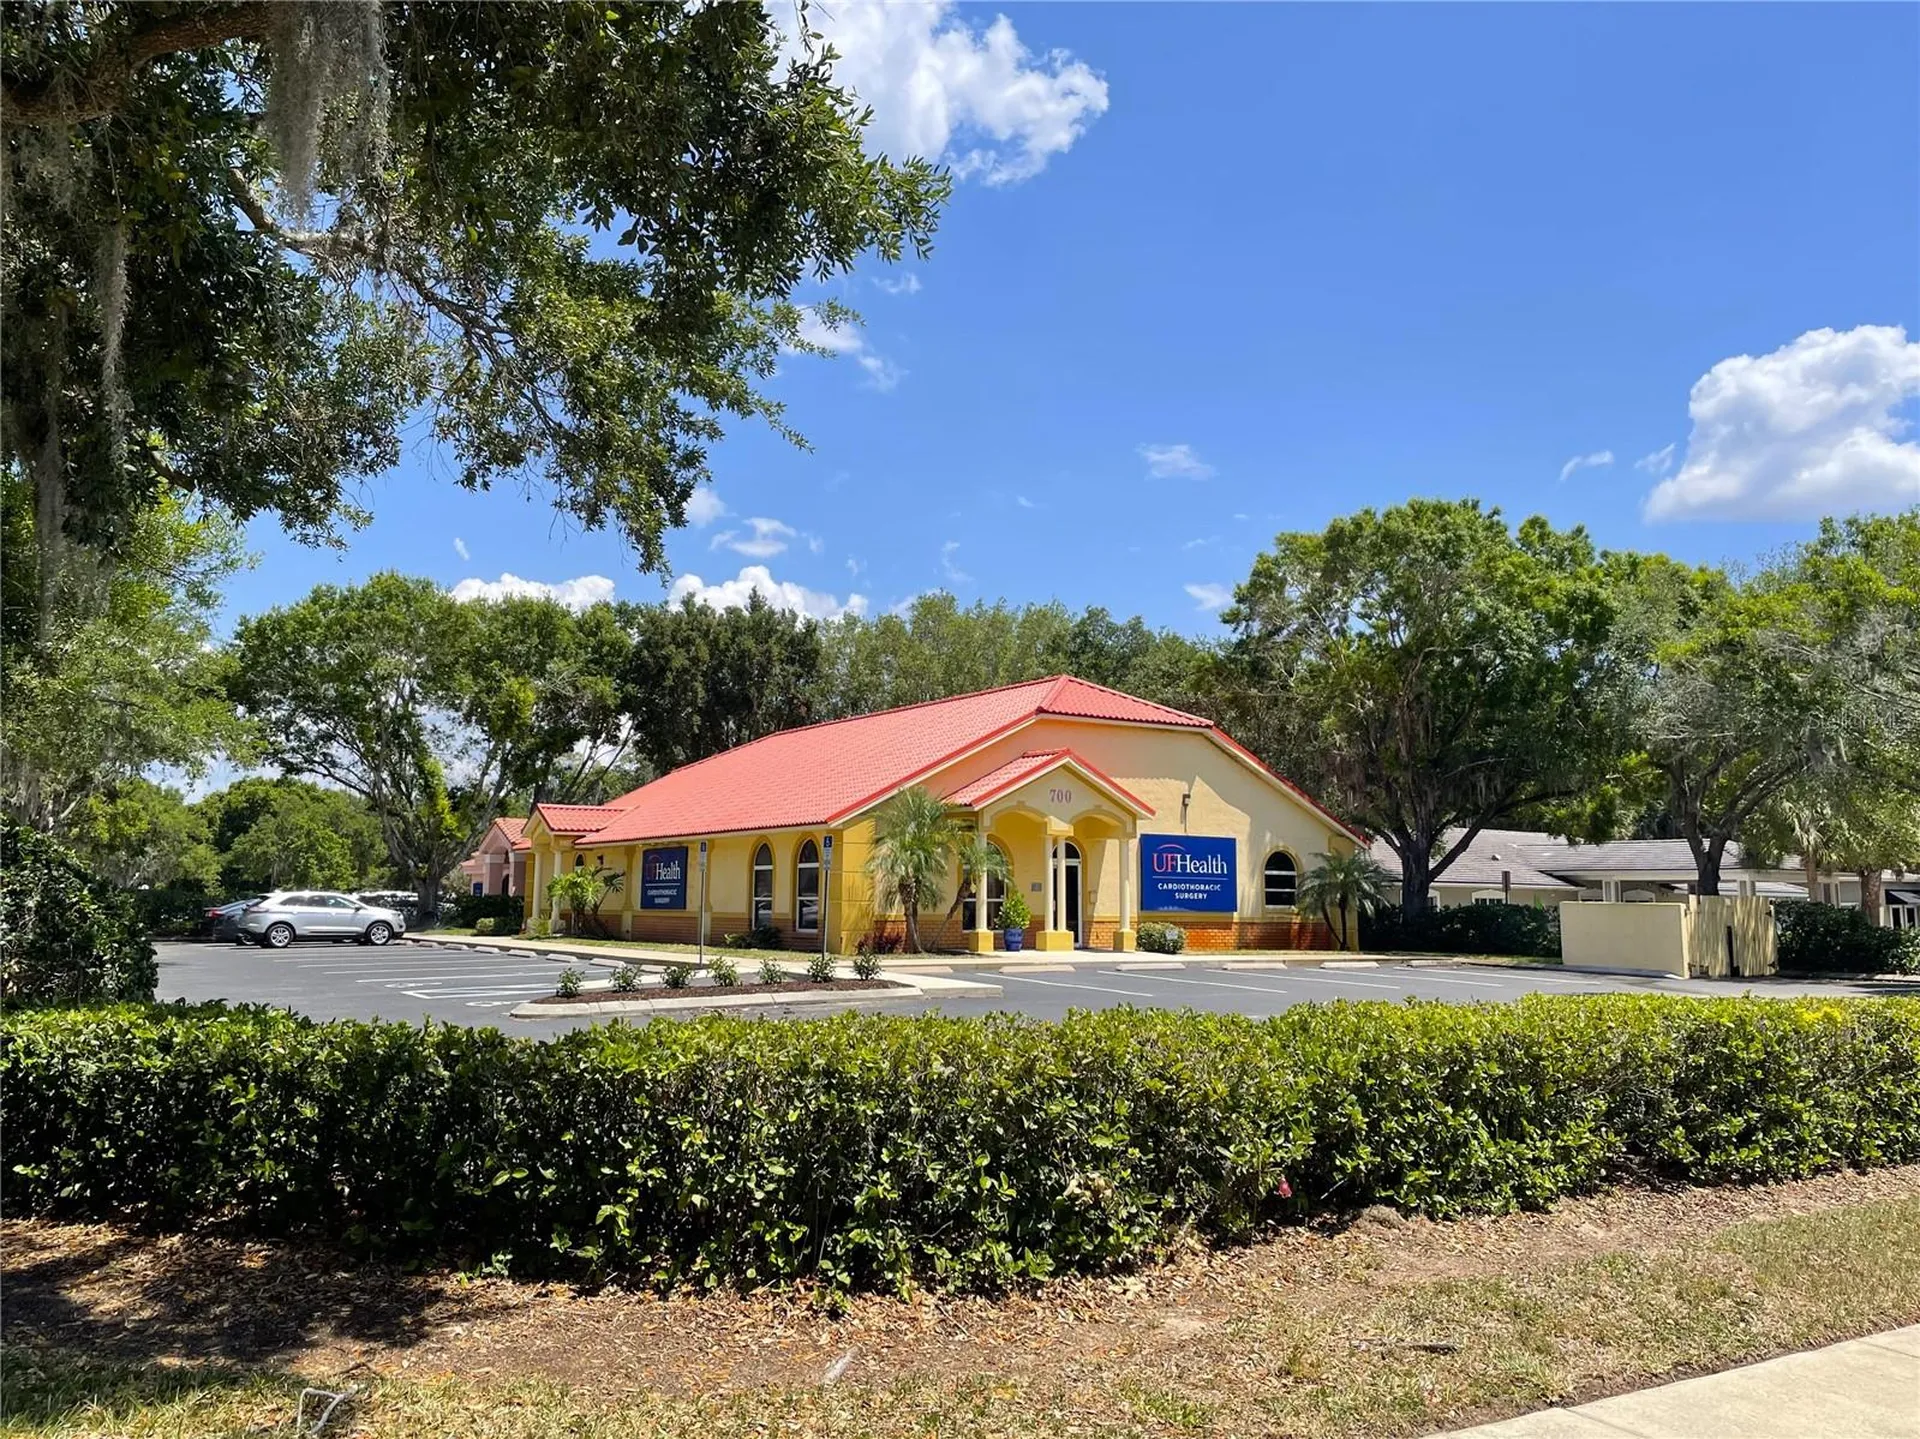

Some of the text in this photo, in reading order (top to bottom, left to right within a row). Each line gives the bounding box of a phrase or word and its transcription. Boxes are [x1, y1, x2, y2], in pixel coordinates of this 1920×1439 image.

[1049, 788, 1072, 803] 700
[1157, 883, 1221, 891] CARDIOTHORACIC
[1174, 892, 1208, 900] SURGERY
